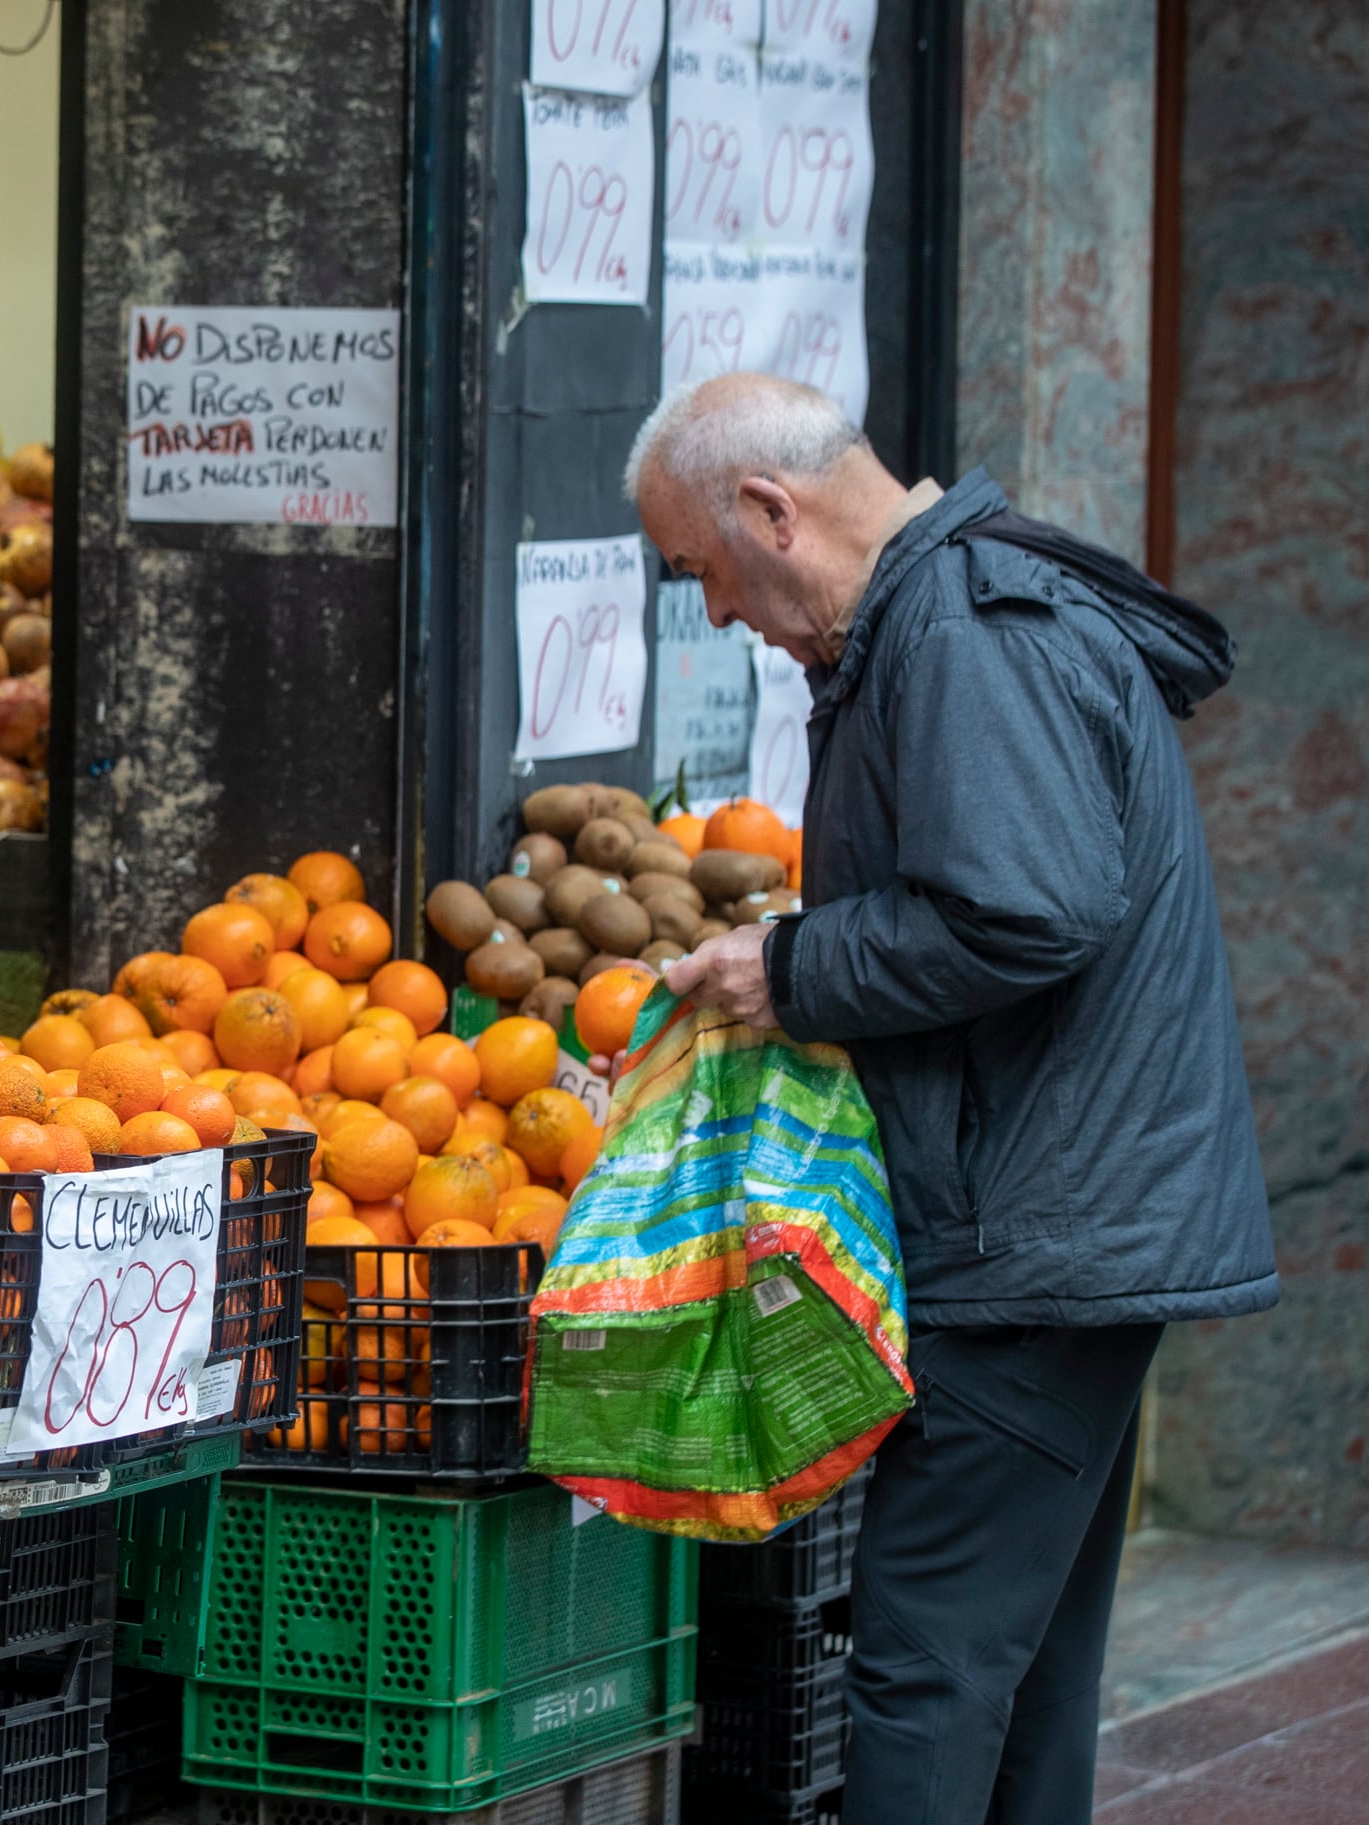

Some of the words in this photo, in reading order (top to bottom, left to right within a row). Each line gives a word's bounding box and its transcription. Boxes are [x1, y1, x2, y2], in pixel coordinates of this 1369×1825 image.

[136, 314, 186, 363] NO
[192, 321, 395, 365] DISPONEMOS
[134, 380, 174, 419] DE
[191, 369, 274, 418] PAGOS
[286, 380, 345, 411] CON
[131, 418, 255, 458] TARJETA
[264, 415, 388, 457] PERDONEN
[143, 465, 192, 498] LAS
[200, 458, 332, 489] MOLESTIAS
[281, 488, 369, 525] GRACIAS
